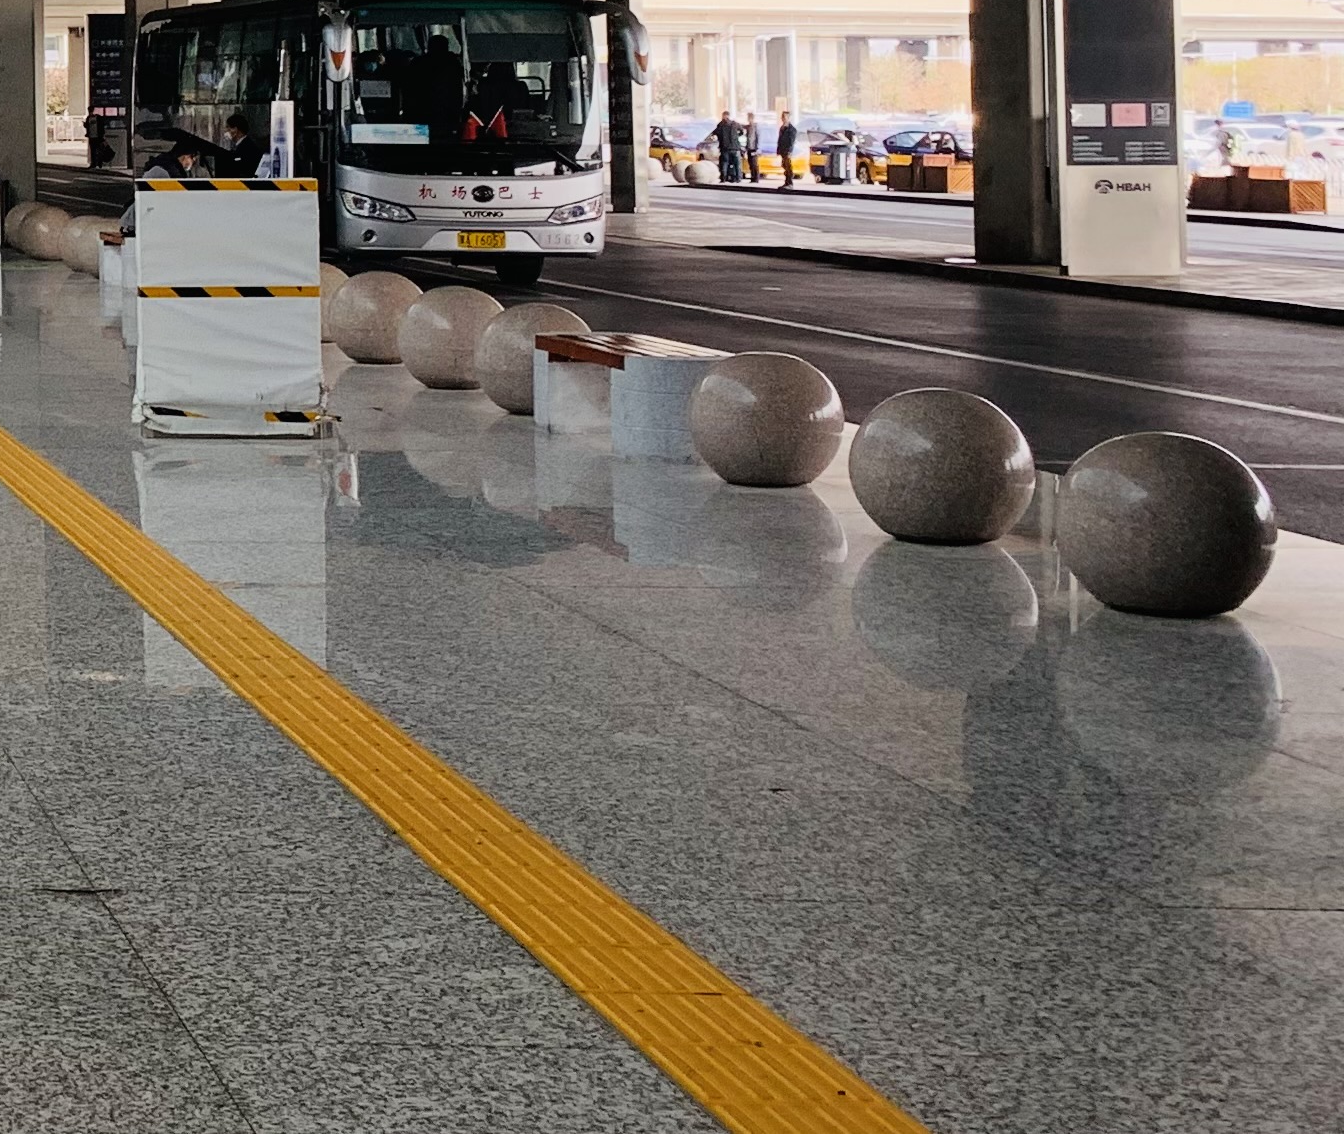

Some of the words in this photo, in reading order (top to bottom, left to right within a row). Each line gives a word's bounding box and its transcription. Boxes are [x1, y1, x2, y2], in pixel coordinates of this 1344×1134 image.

[418, 183, 544, 201] 机场巴士
[1116, 183, 1151, 192] HBAH
[462, 210, 504, 218] YUTONG
